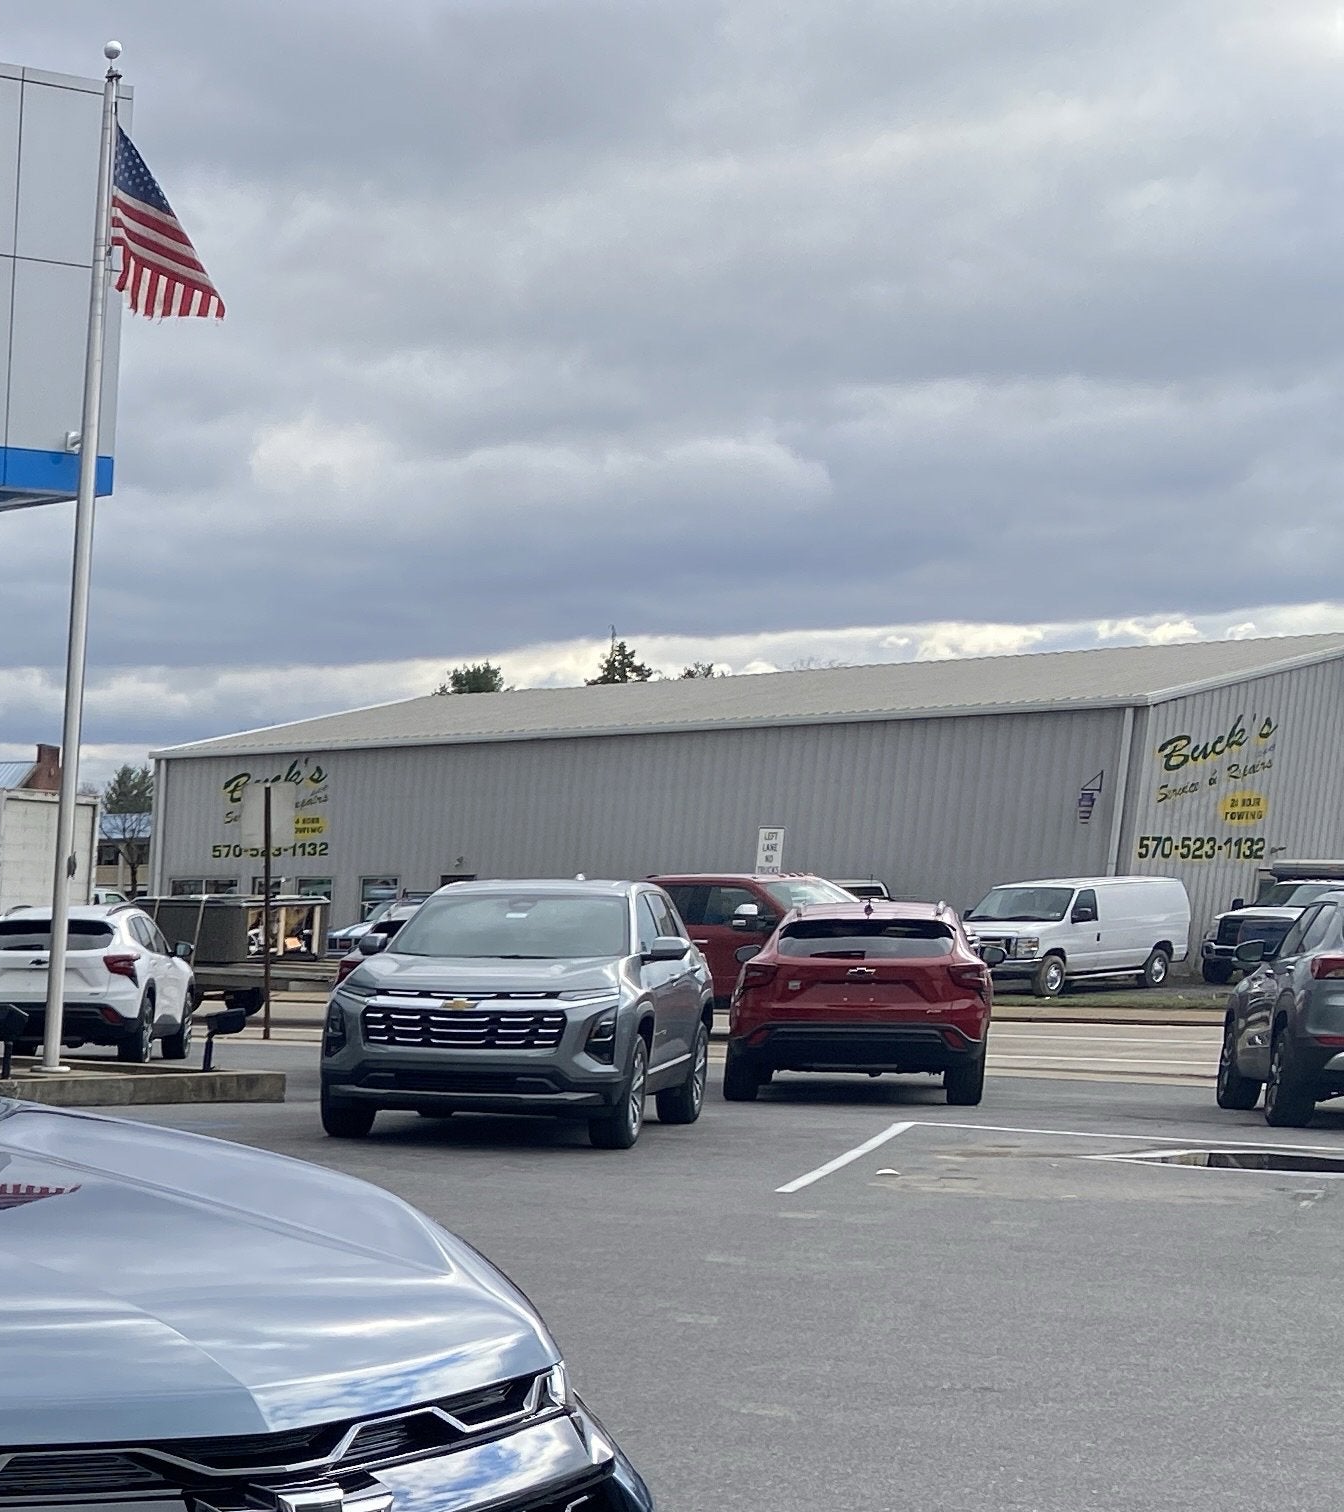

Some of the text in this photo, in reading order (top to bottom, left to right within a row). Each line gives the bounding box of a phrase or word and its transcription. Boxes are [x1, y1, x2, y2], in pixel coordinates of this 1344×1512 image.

[1158, 713, 1278, 771] Buck's
[1224, 810, 1263, 821] TOWING
[1137, 836, 1266, 860] 570-523-1132
